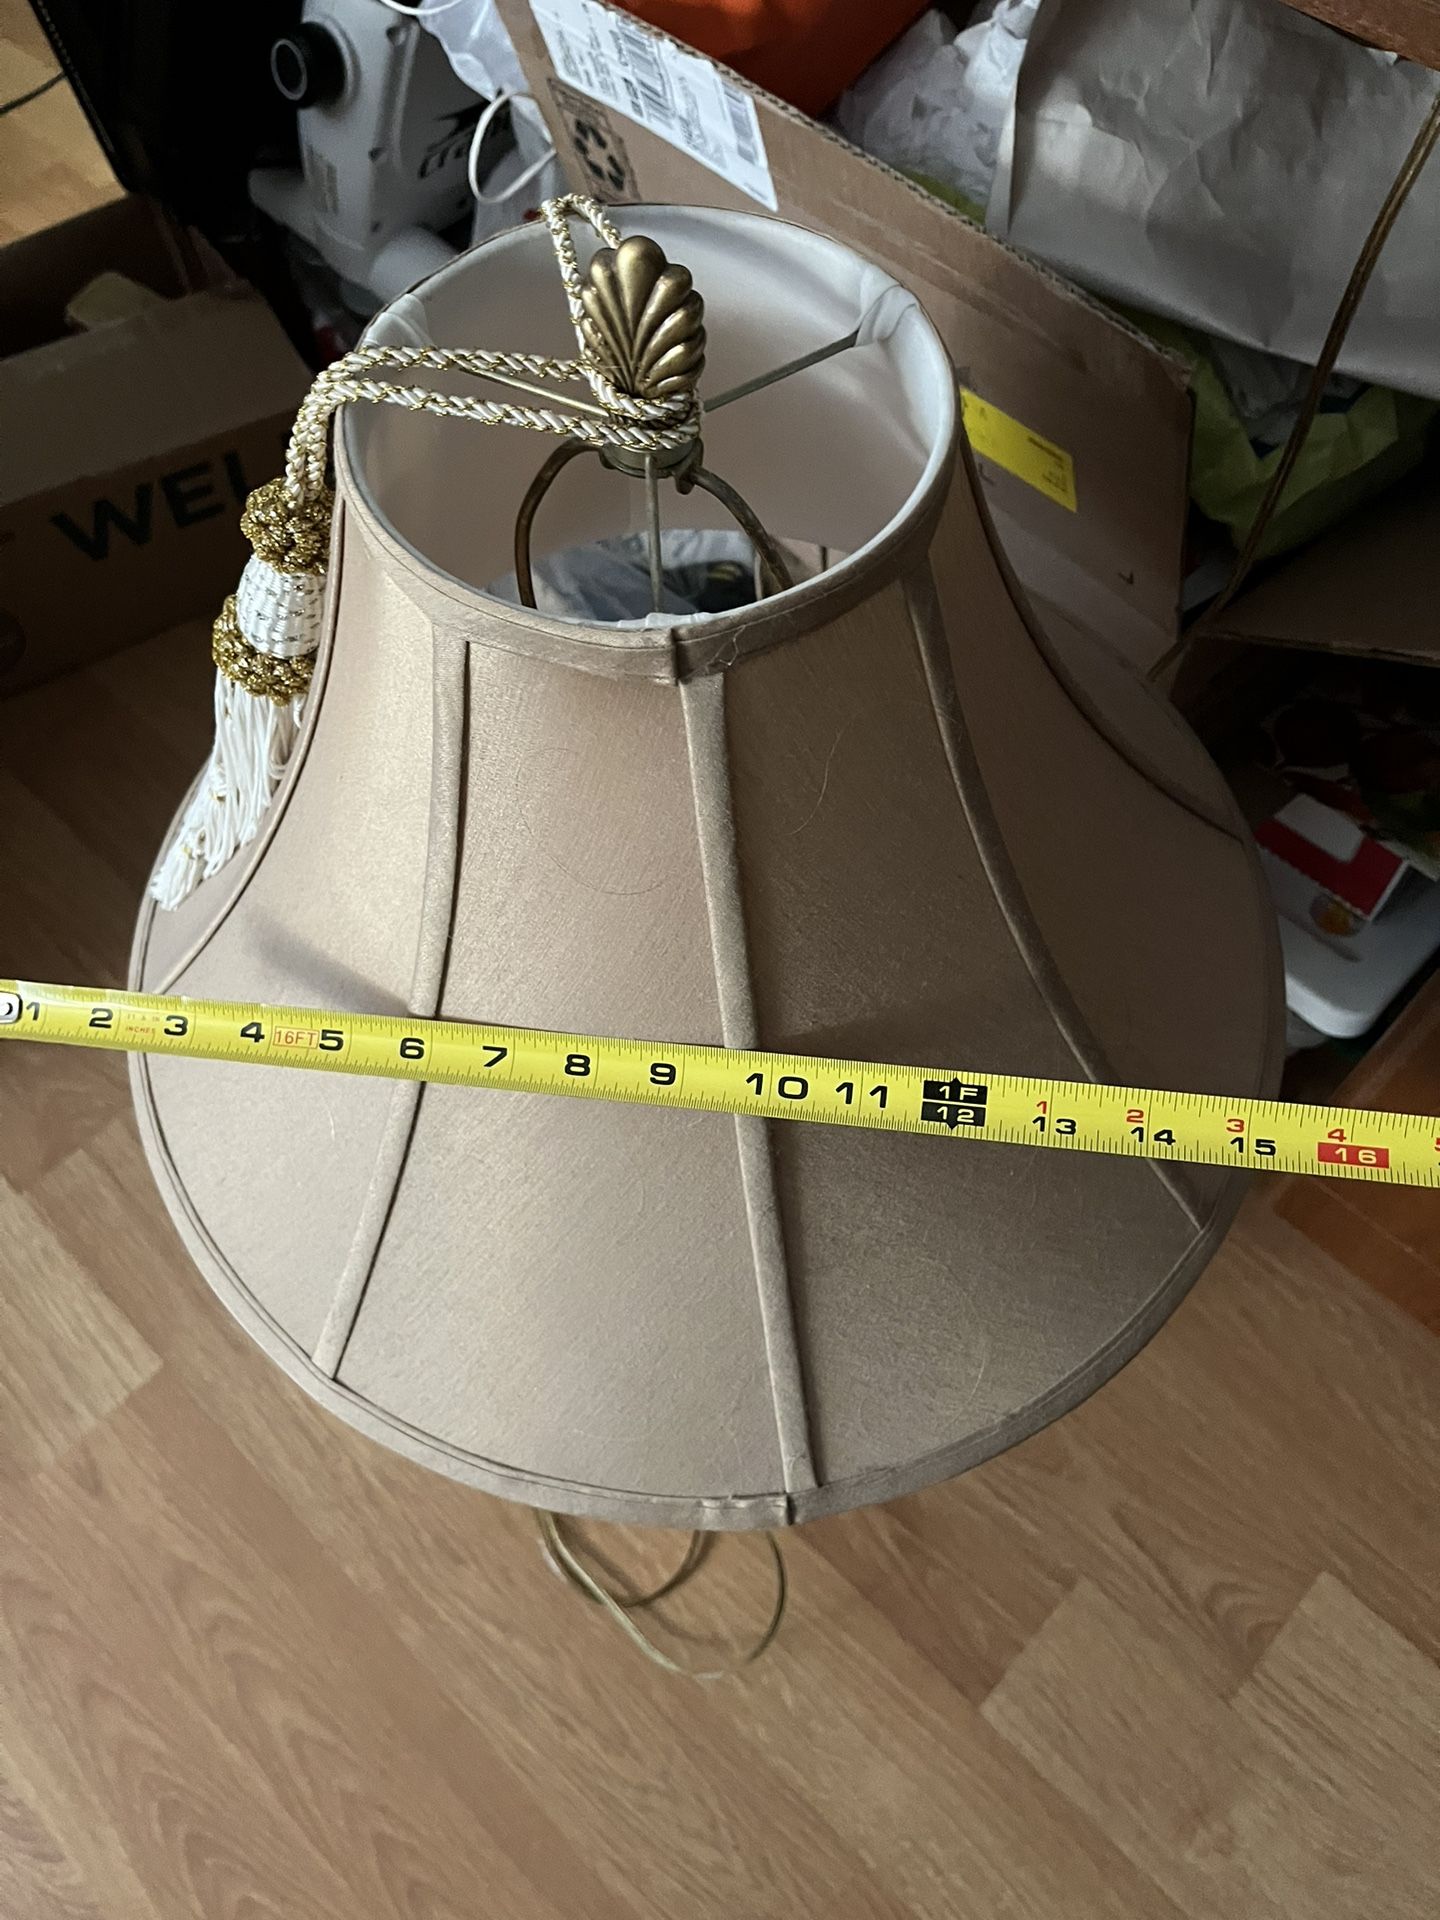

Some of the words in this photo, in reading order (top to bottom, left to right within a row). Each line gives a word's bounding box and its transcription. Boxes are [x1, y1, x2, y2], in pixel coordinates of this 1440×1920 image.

[26, 1001, 40, 1021] 1
[88, 1007, 113, 1029] 2
[163, 1015, 189, 1036] 3
[240, 1022, 265, 1043] 4
[318, 1029, 344, 1051] 5
[399, 1037, 425, 1060] 6
[482, 1046, 508, 1067] 7
[564, 1054, 591, 1076] 8
[650, 1062, 677, 1086] 9
[746, 1072, 809, 1100] 10
[836, 1082, 888, 1109] 11
[275, 1029, 318, 1047] 16FT
[936, 1105, 975, 1123] 12
[1036, 1101, 1047, 1115] 1
[1126, 1109, 1145, 1123] 2
[1226, 1119, 1245, 1132] 3
[1327, 1128, 1347, 1142] 4
[1032, 1116, 1077, 1135] 13
[1131, 1126, 1176, 1146] 14
[1230, 1136, 1276, 1156] 15
[1335, 1147, 1377, 1165] 16
